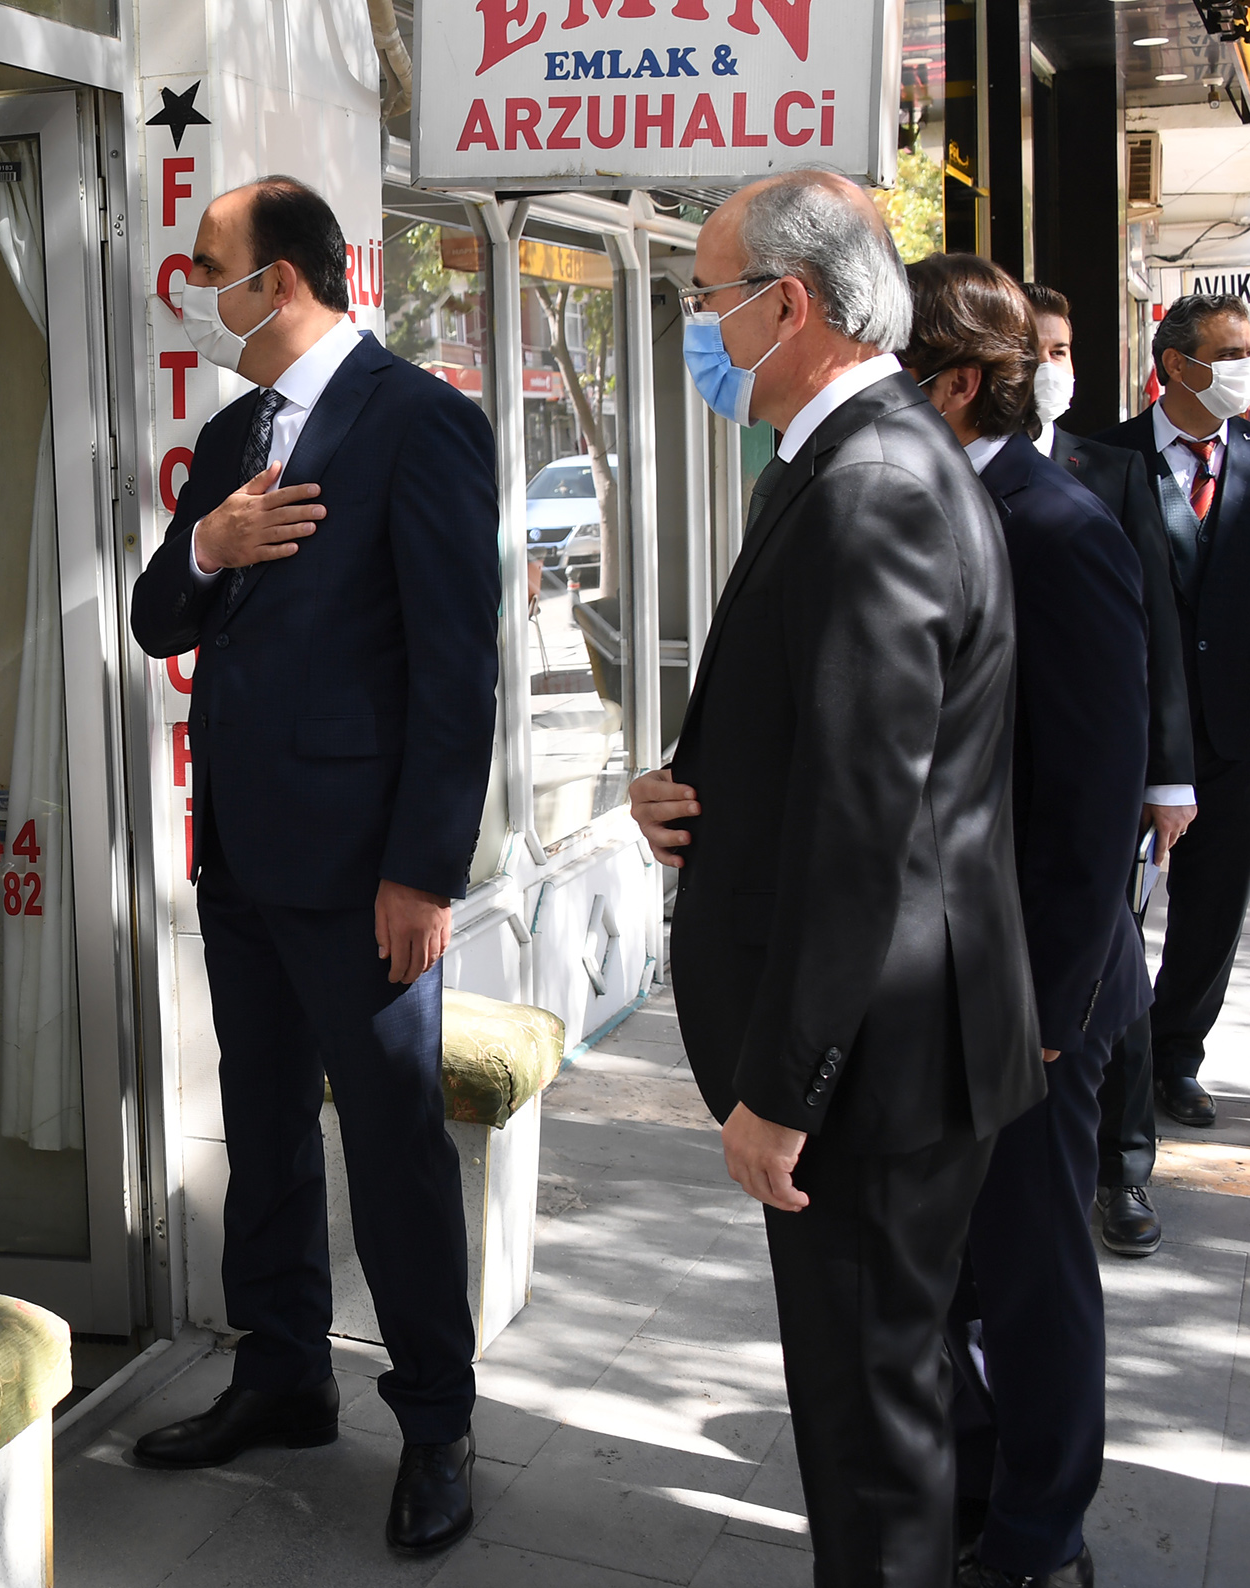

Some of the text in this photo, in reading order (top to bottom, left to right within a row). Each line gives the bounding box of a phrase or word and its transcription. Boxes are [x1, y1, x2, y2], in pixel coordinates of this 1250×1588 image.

[544, 44, 738, 80] EMLAK &
[4, 871, 43, 916] 82
